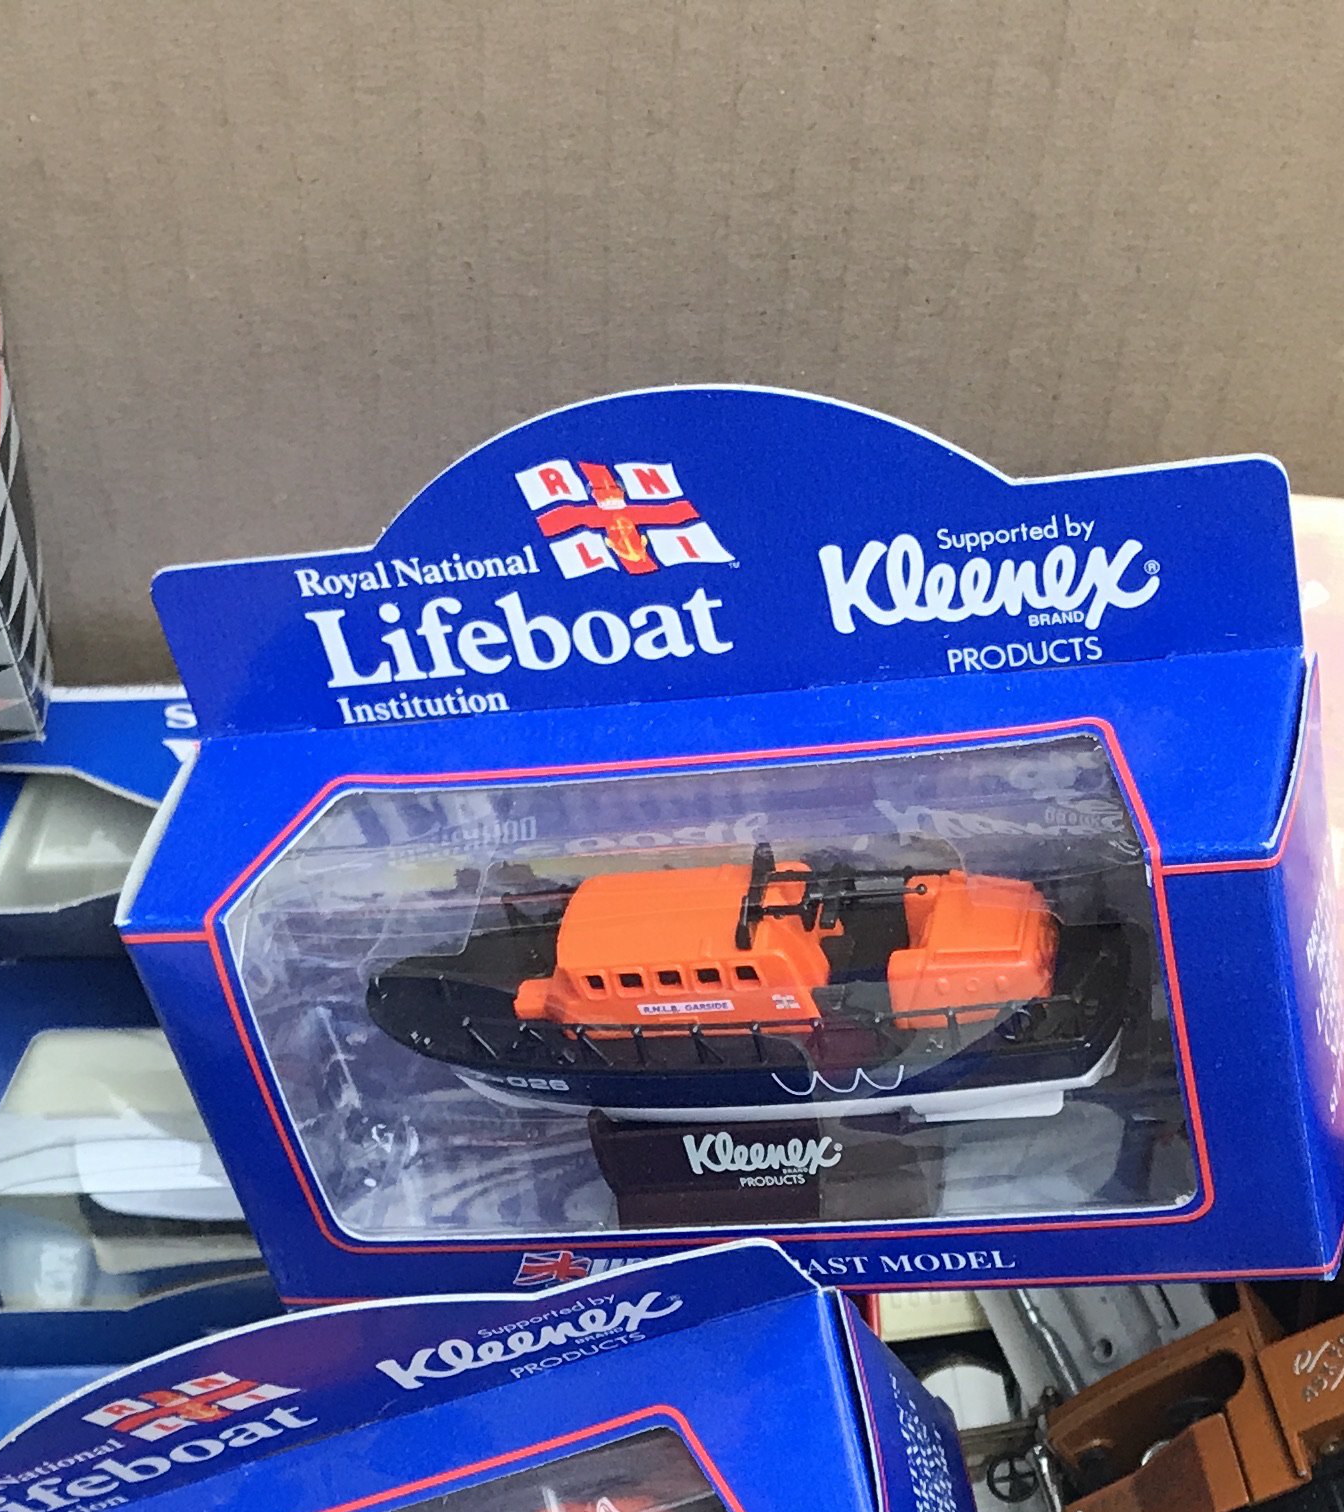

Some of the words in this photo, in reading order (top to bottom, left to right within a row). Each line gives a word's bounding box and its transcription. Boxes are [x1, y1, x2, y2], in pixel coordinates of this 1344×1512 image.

[937, 518, 1060, 553] Supported
[1065, 514, 1095, 542] by
[296, 564, 392, 599] Royal
[392, 546, 540, 591] National
[304, 587, 733, 688] Lifeboat
[1028, 609, 1085, 628] BRAND
[947, 636, 1103, 673] PRODUCTS
[336, 686, 510, 726] Institution
[739, 1172, 805, 1189] PRODUCTS
[880, 1248, 1017, 1275] MODEL
[476, 1296, 582, 1340] Supported
[584, 1293, 615, 1314] by
[510, 1331, 647, 1380] PRODUCTS
